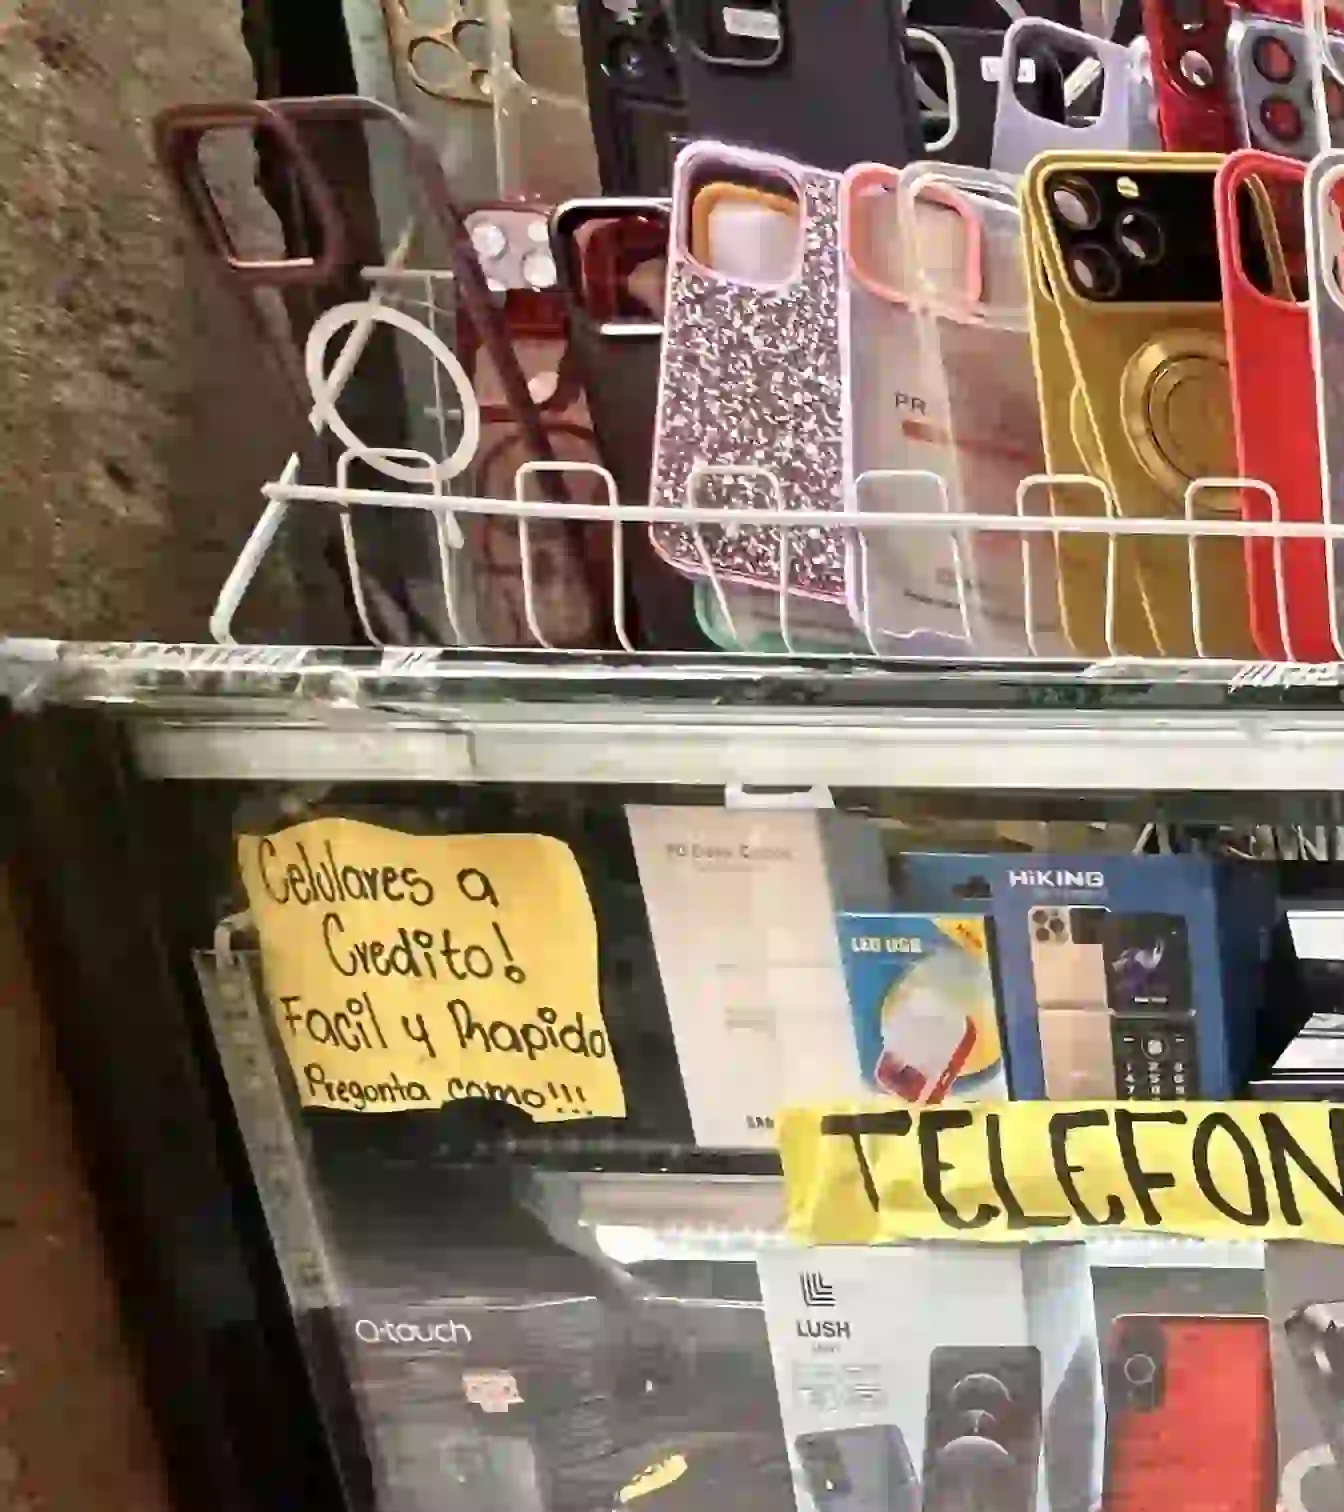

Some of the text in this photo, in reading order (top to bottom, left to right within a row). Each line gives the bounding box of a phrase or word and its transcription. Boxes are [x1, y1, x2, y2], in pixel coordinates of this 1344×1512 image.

[258, 838, 498, 908] Celulares a
[321, 915, 528, 986] Credito!
[280, 992, 388, 1050] Facil
[401, 1013, 436, 1059] y
[795, 1319, 852, 1341] LUSH
